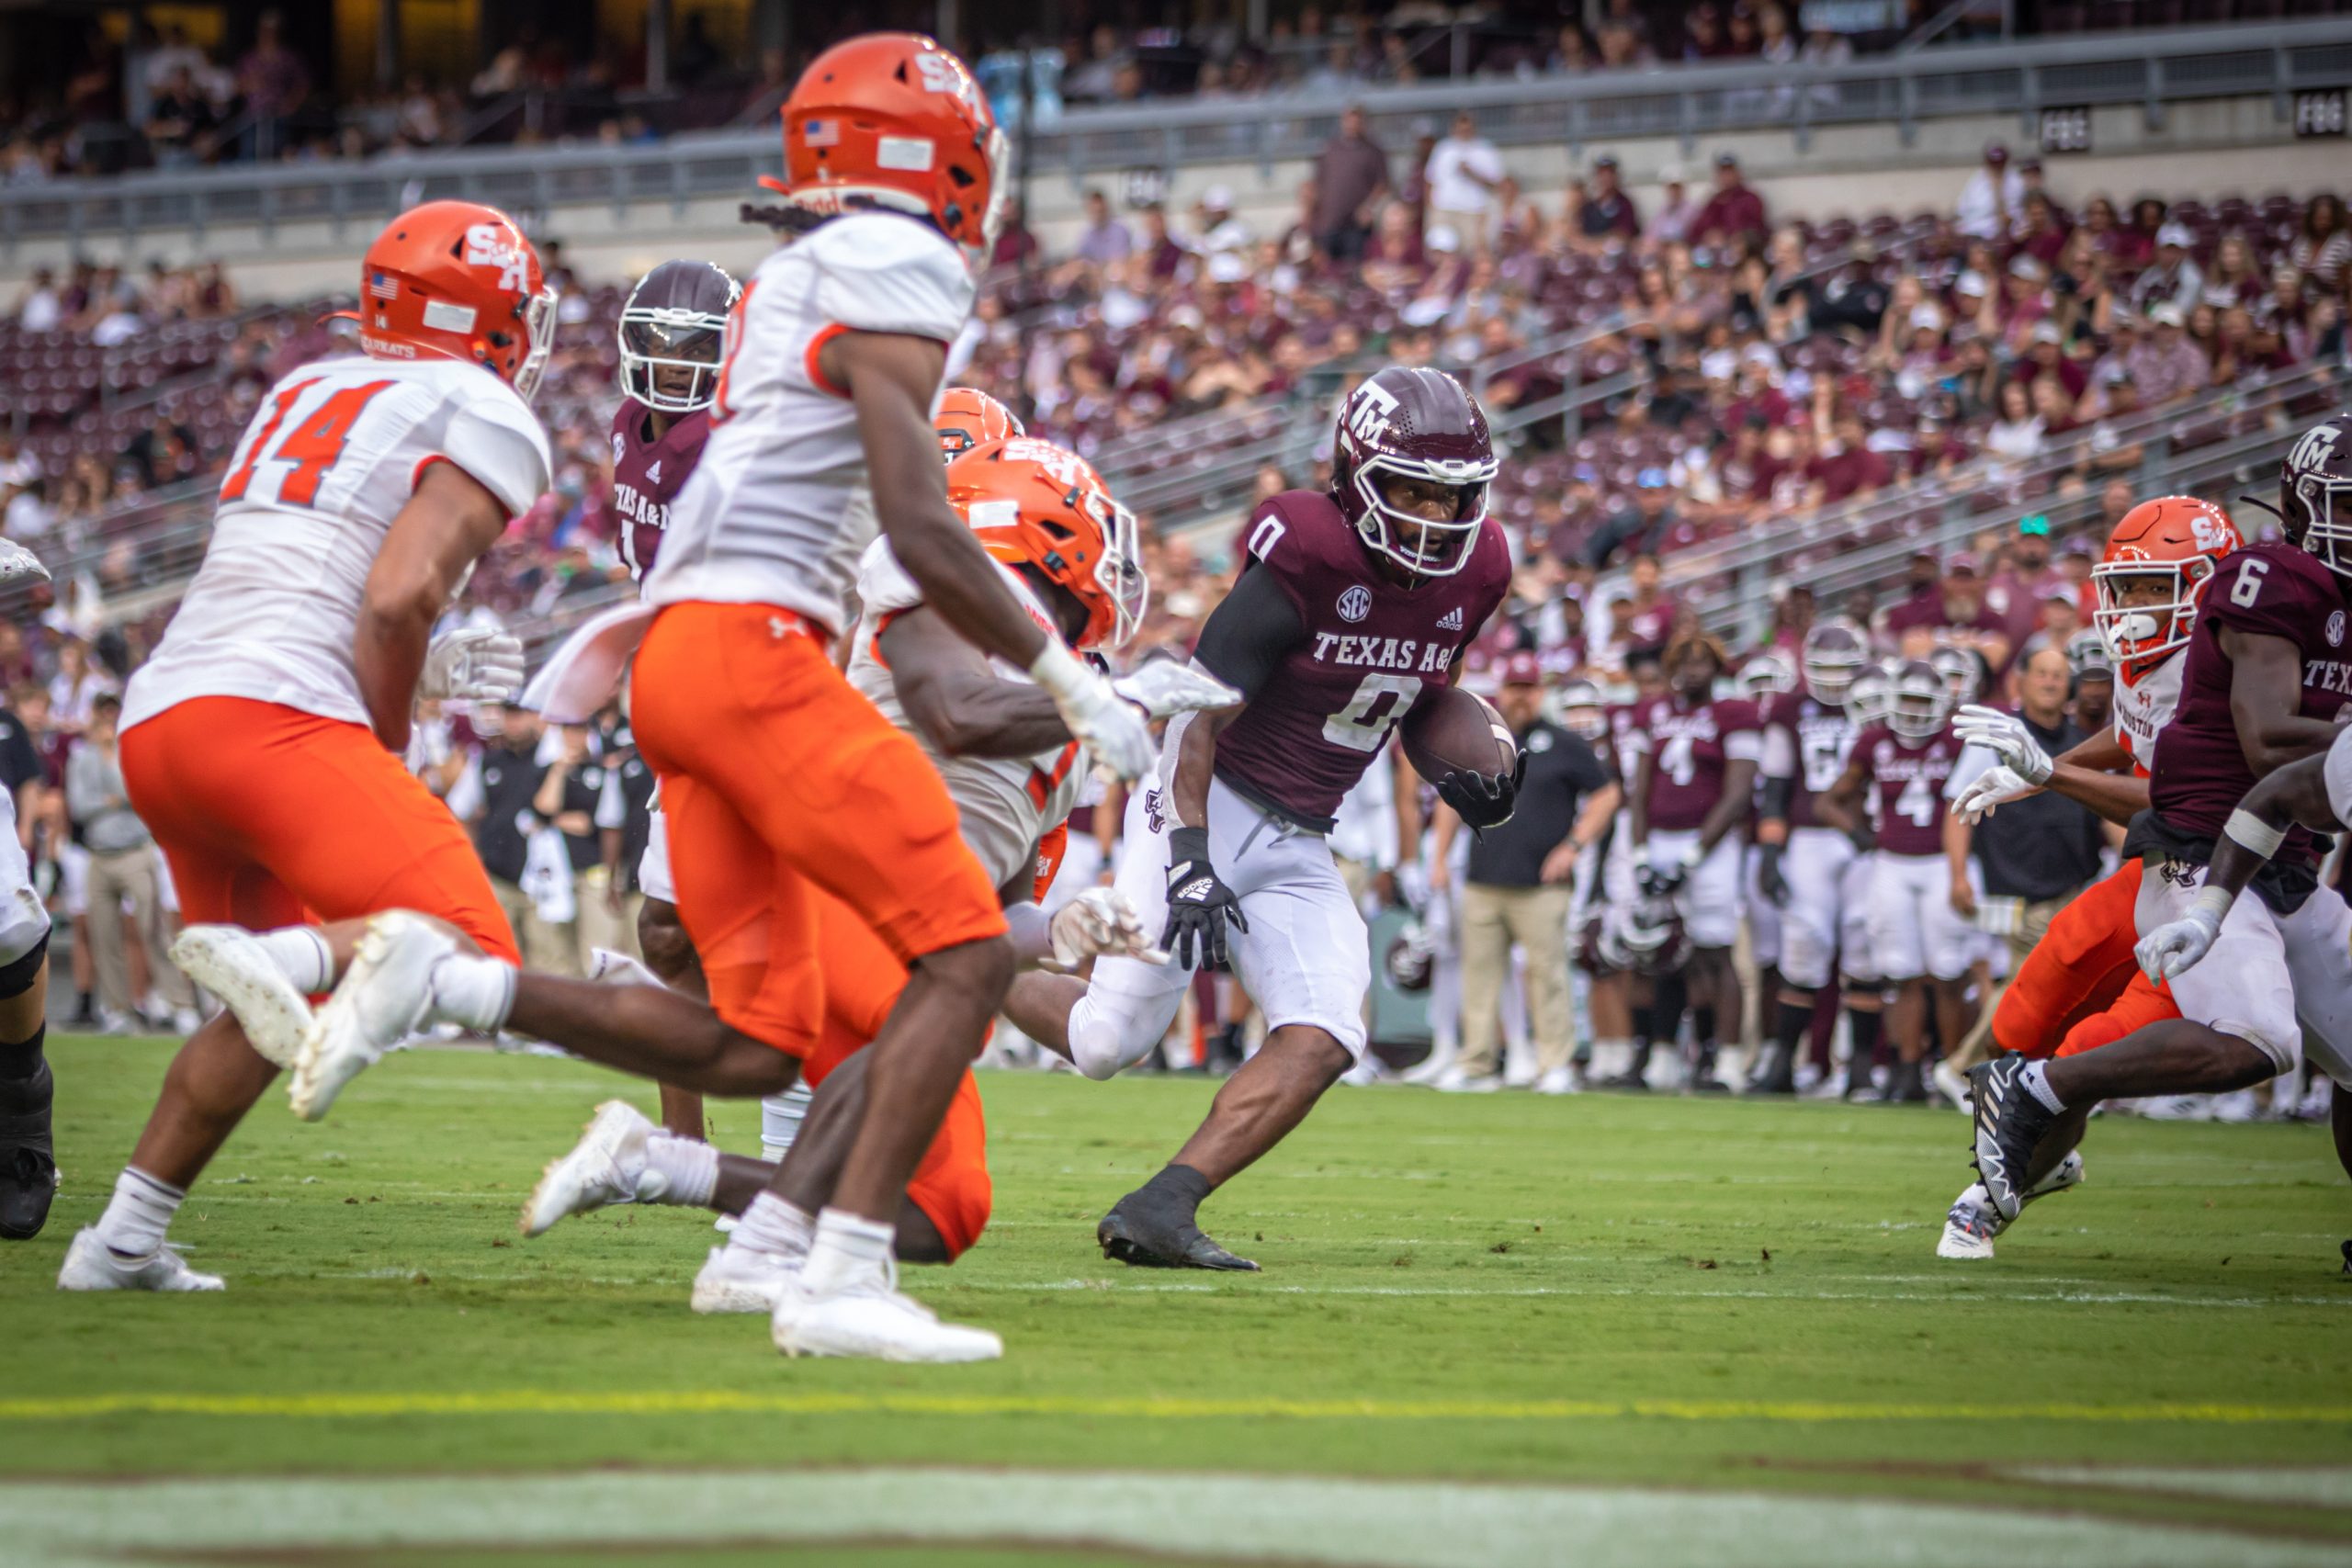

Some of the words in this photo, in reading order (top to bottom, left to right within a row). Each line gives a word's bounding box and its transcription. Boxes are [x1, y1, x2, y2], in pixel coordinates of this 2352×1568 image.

[214, 375, 401, 509] 14
[614, 483, 638, 516] XAS
[1340, 587, 1370, 621] SEC
[2230, 558, 2269, 609] 6
[1436, 620, 1464, 632] adidas
[1313, 631, 1417, 671] TEXAS
[1418, 643, 1459, 673] A&
[2302, 660, 2352, 696] TEX
[1321, 671, 1423, 753] 0
[1658, 731, 1697, 787] 4
[1894, 776, 1936, 828] 4
[1177, 877, 1214, 899] adidas
